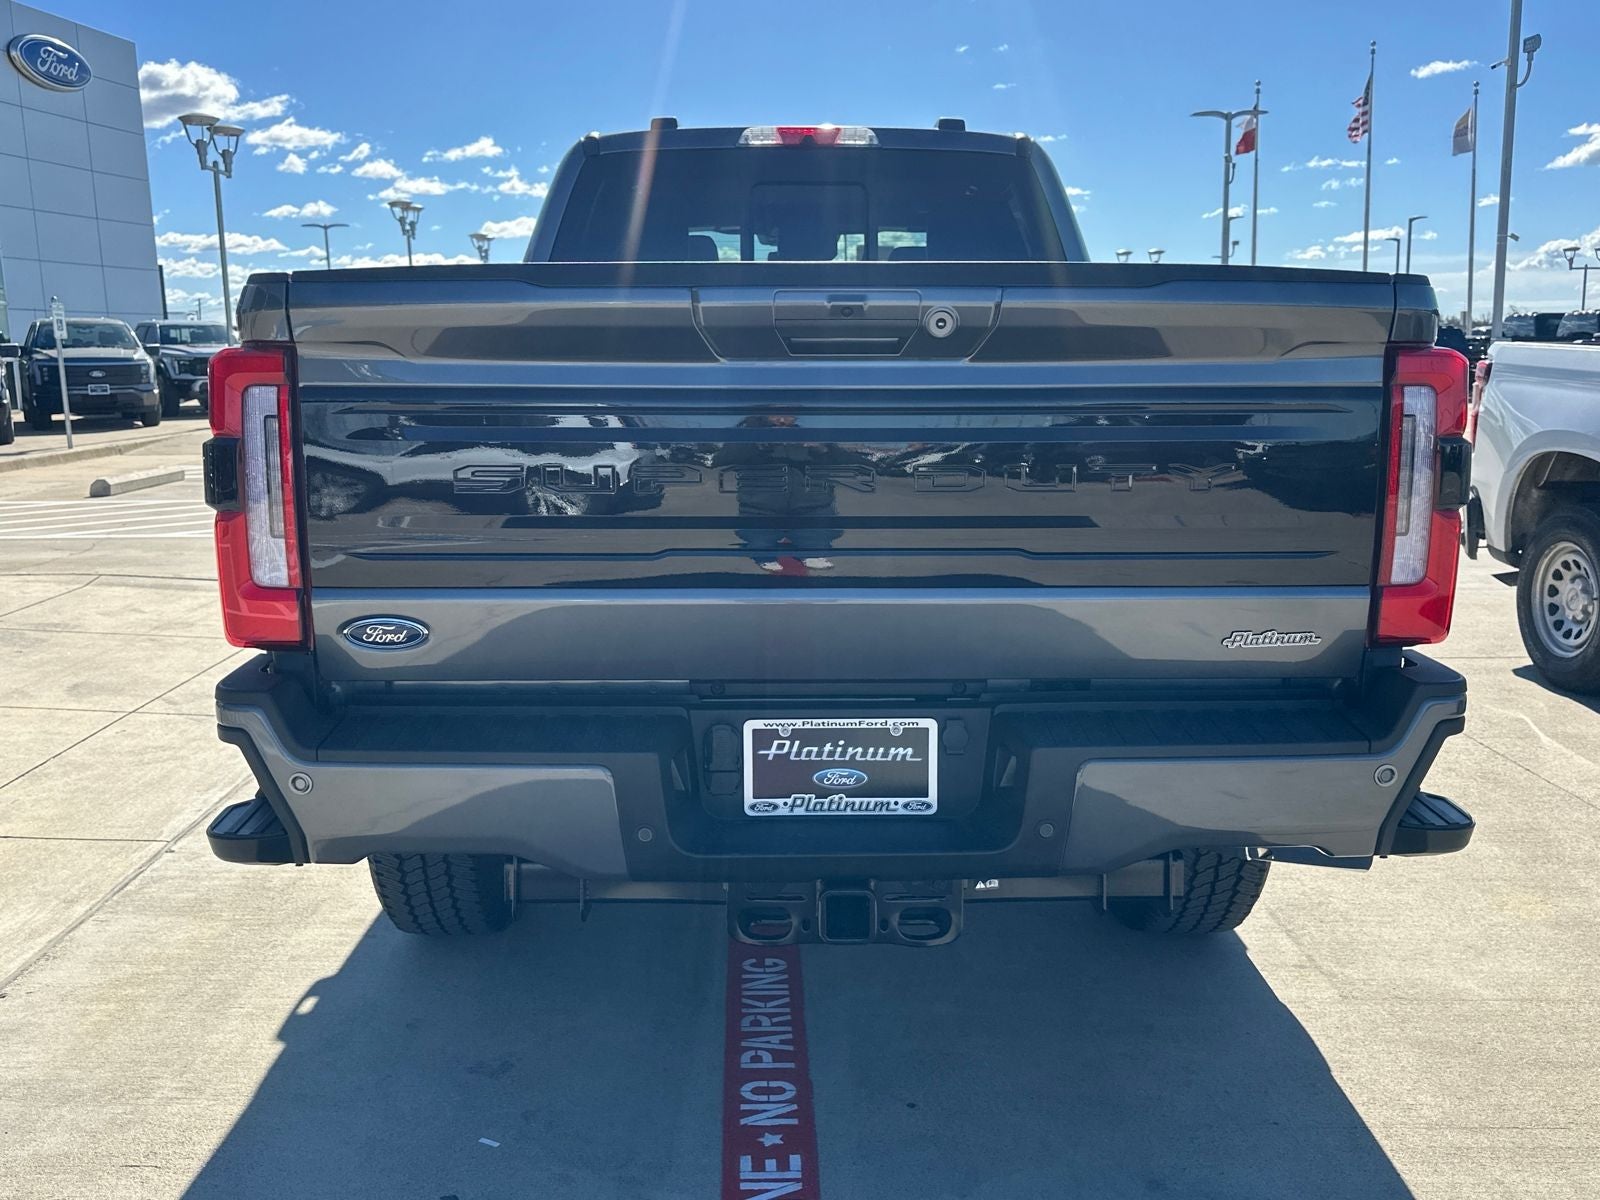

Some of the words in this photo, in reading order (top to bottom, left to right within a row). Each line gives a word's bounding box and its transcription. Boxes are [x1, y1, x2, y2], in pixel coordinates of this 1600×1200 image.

[37, 46, 79, 81] Ford
[913, 462, 1237, 493] DUTY
[362, 624, 409, 643] Ford
[1222, 629, 1322, 649] Platinum
[763, 720, 919, 728] www.PlatinumFord.com
[756, 739, 923, 761] Platinum
[823, 771, 856, 785] Ford
[753, 803, 774, 812] Ford
[789, 794, 899, 813] Platinum
[906, 802, 928, 811] Ford
[740, 956, 796, 1069] PARKING
[739, 1080, 799, 1127] NO
